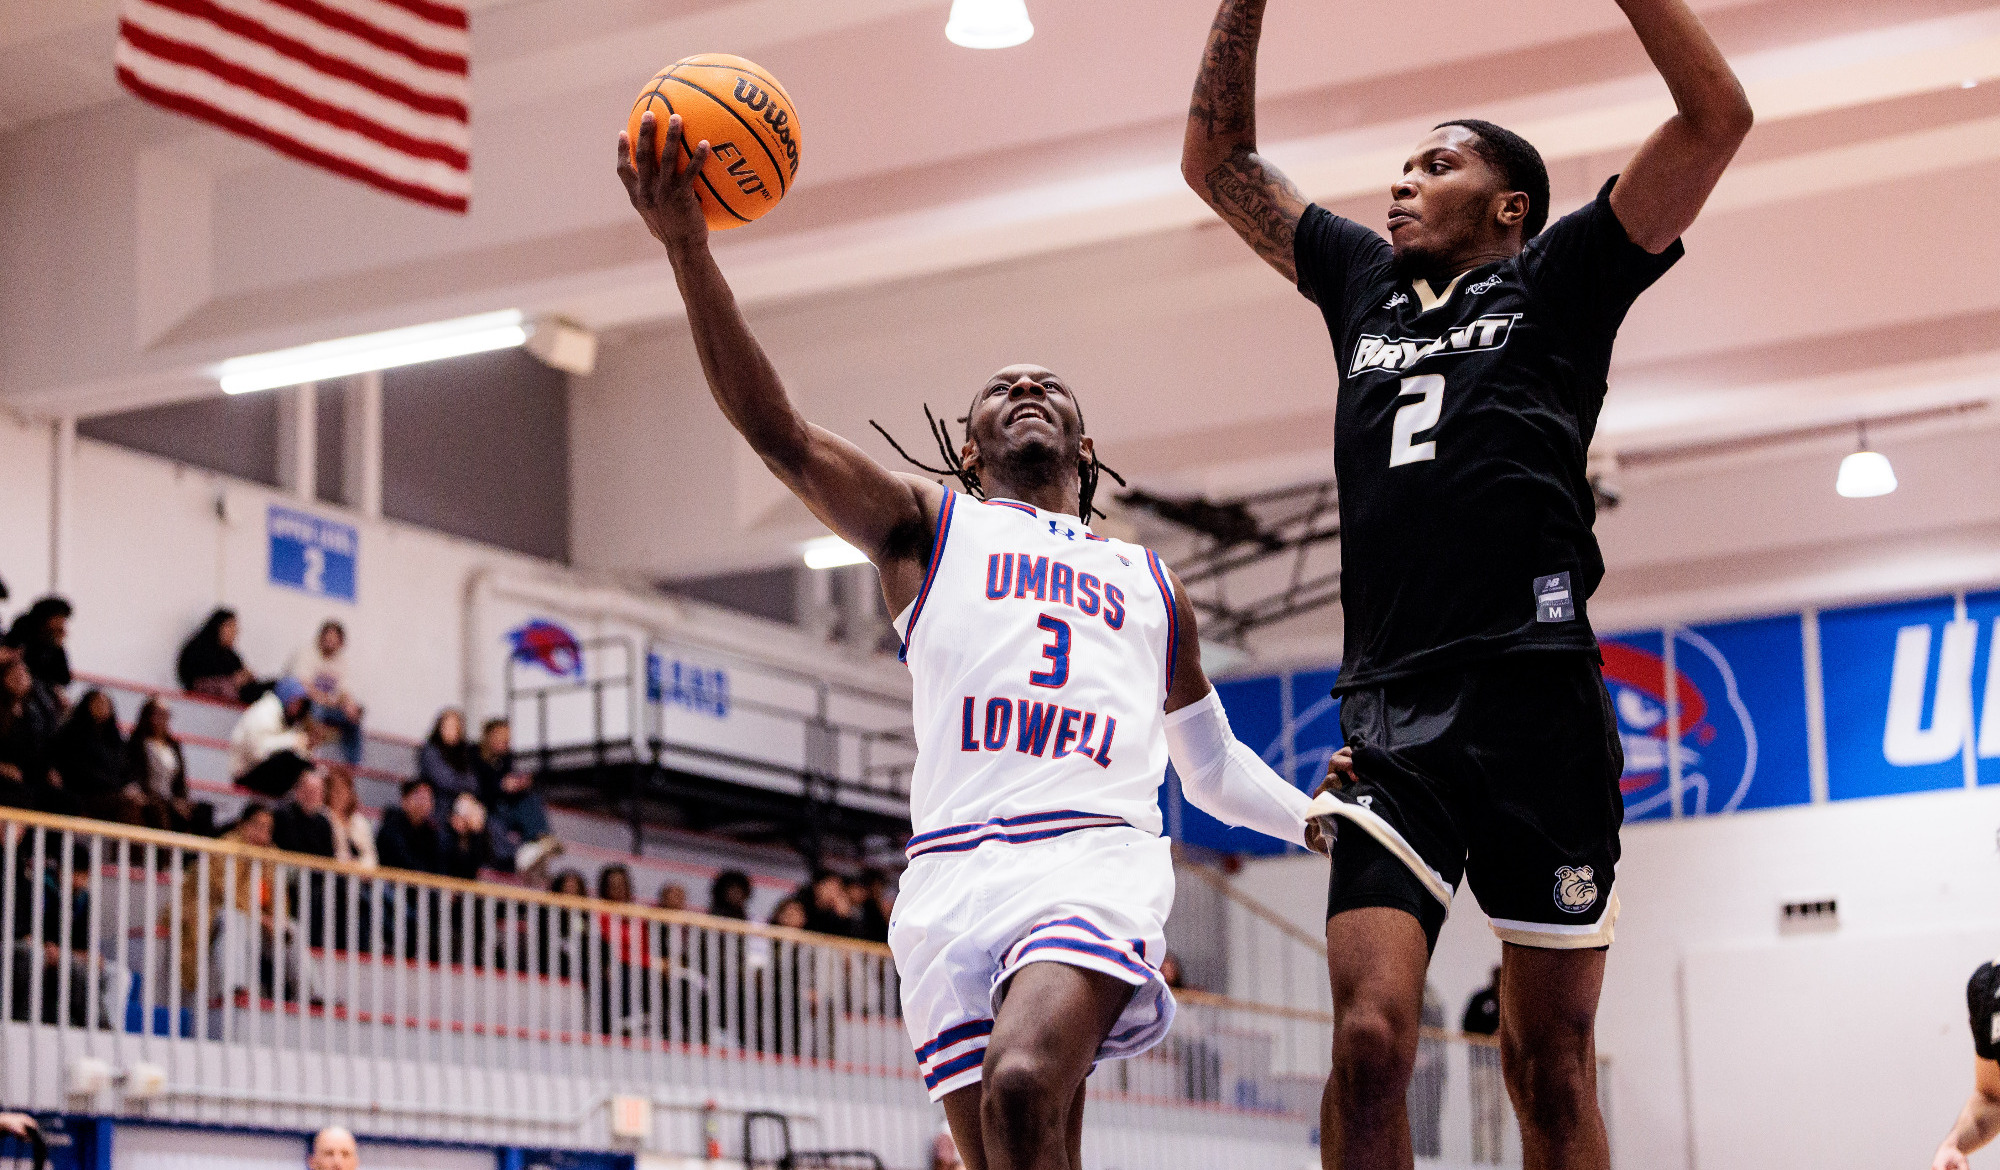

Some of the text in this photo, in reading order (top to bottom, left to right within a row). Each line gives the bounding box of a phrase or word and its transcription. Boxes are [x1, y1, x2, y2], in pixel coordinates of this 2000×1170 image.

[732, 76, 801, 180] Wilson
[711, 141, 764, 196] EVO
[1389, 373, 1446, 468] 2
[303, 547, 326, 593] 2
[985, 552, 1126, 631] UMASS
[1548, 606, 1562, 618] M
[1029, 612, 1072, 689] 3
[961, 696, 1116, 769] LOWELL
